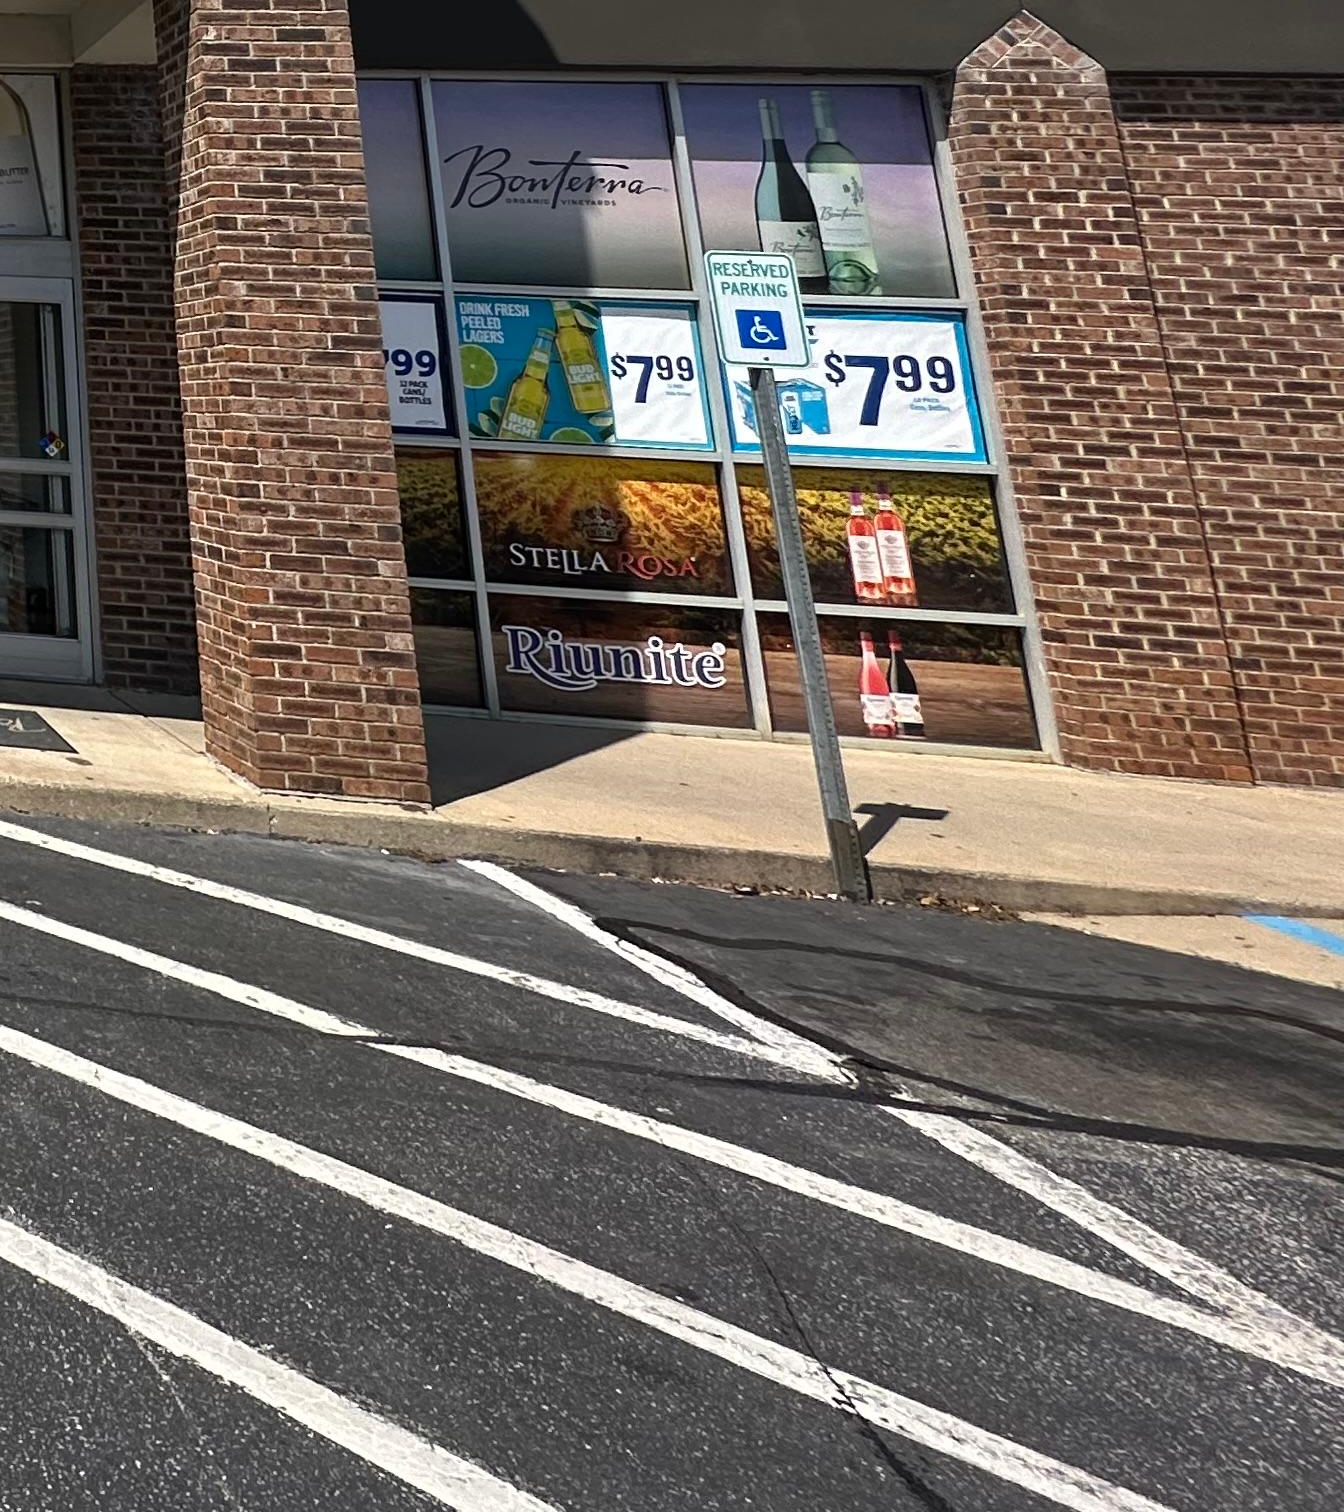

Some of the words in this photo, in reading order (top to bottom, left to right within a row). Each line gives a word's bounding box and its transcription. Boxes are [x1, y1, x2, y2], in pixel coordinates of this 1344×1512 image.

[444, 144, 669, 210] Bonterra
[505, 197, 551, 205] ORGANIC
[561, 199, 617, 207] VINEYARDS
[712, 262, 790, 279] RESERVED
[720, 281, 788, 298] PARKING
[459, 301, 494, 316] DRINK
[494, 303, 530, 317] FRESH
[461, 316, 502, 329] PEELED
[462, 330, 505, 344] LAGERS
[568, 363, 595, 375] BUD
[411, 380, 429, 389] PACK
[567, 372, 602, 385] LIGHT
[398, 396, 433, 405] BOTTLES
[508, 412, 537, 429] BUD
[501, 419, 539, 439] LIGHT
[509, 542, 612, 575] STELLA
[616, 550, 698, 581] ROSA
[502, 624, 727, 692] Riunite
